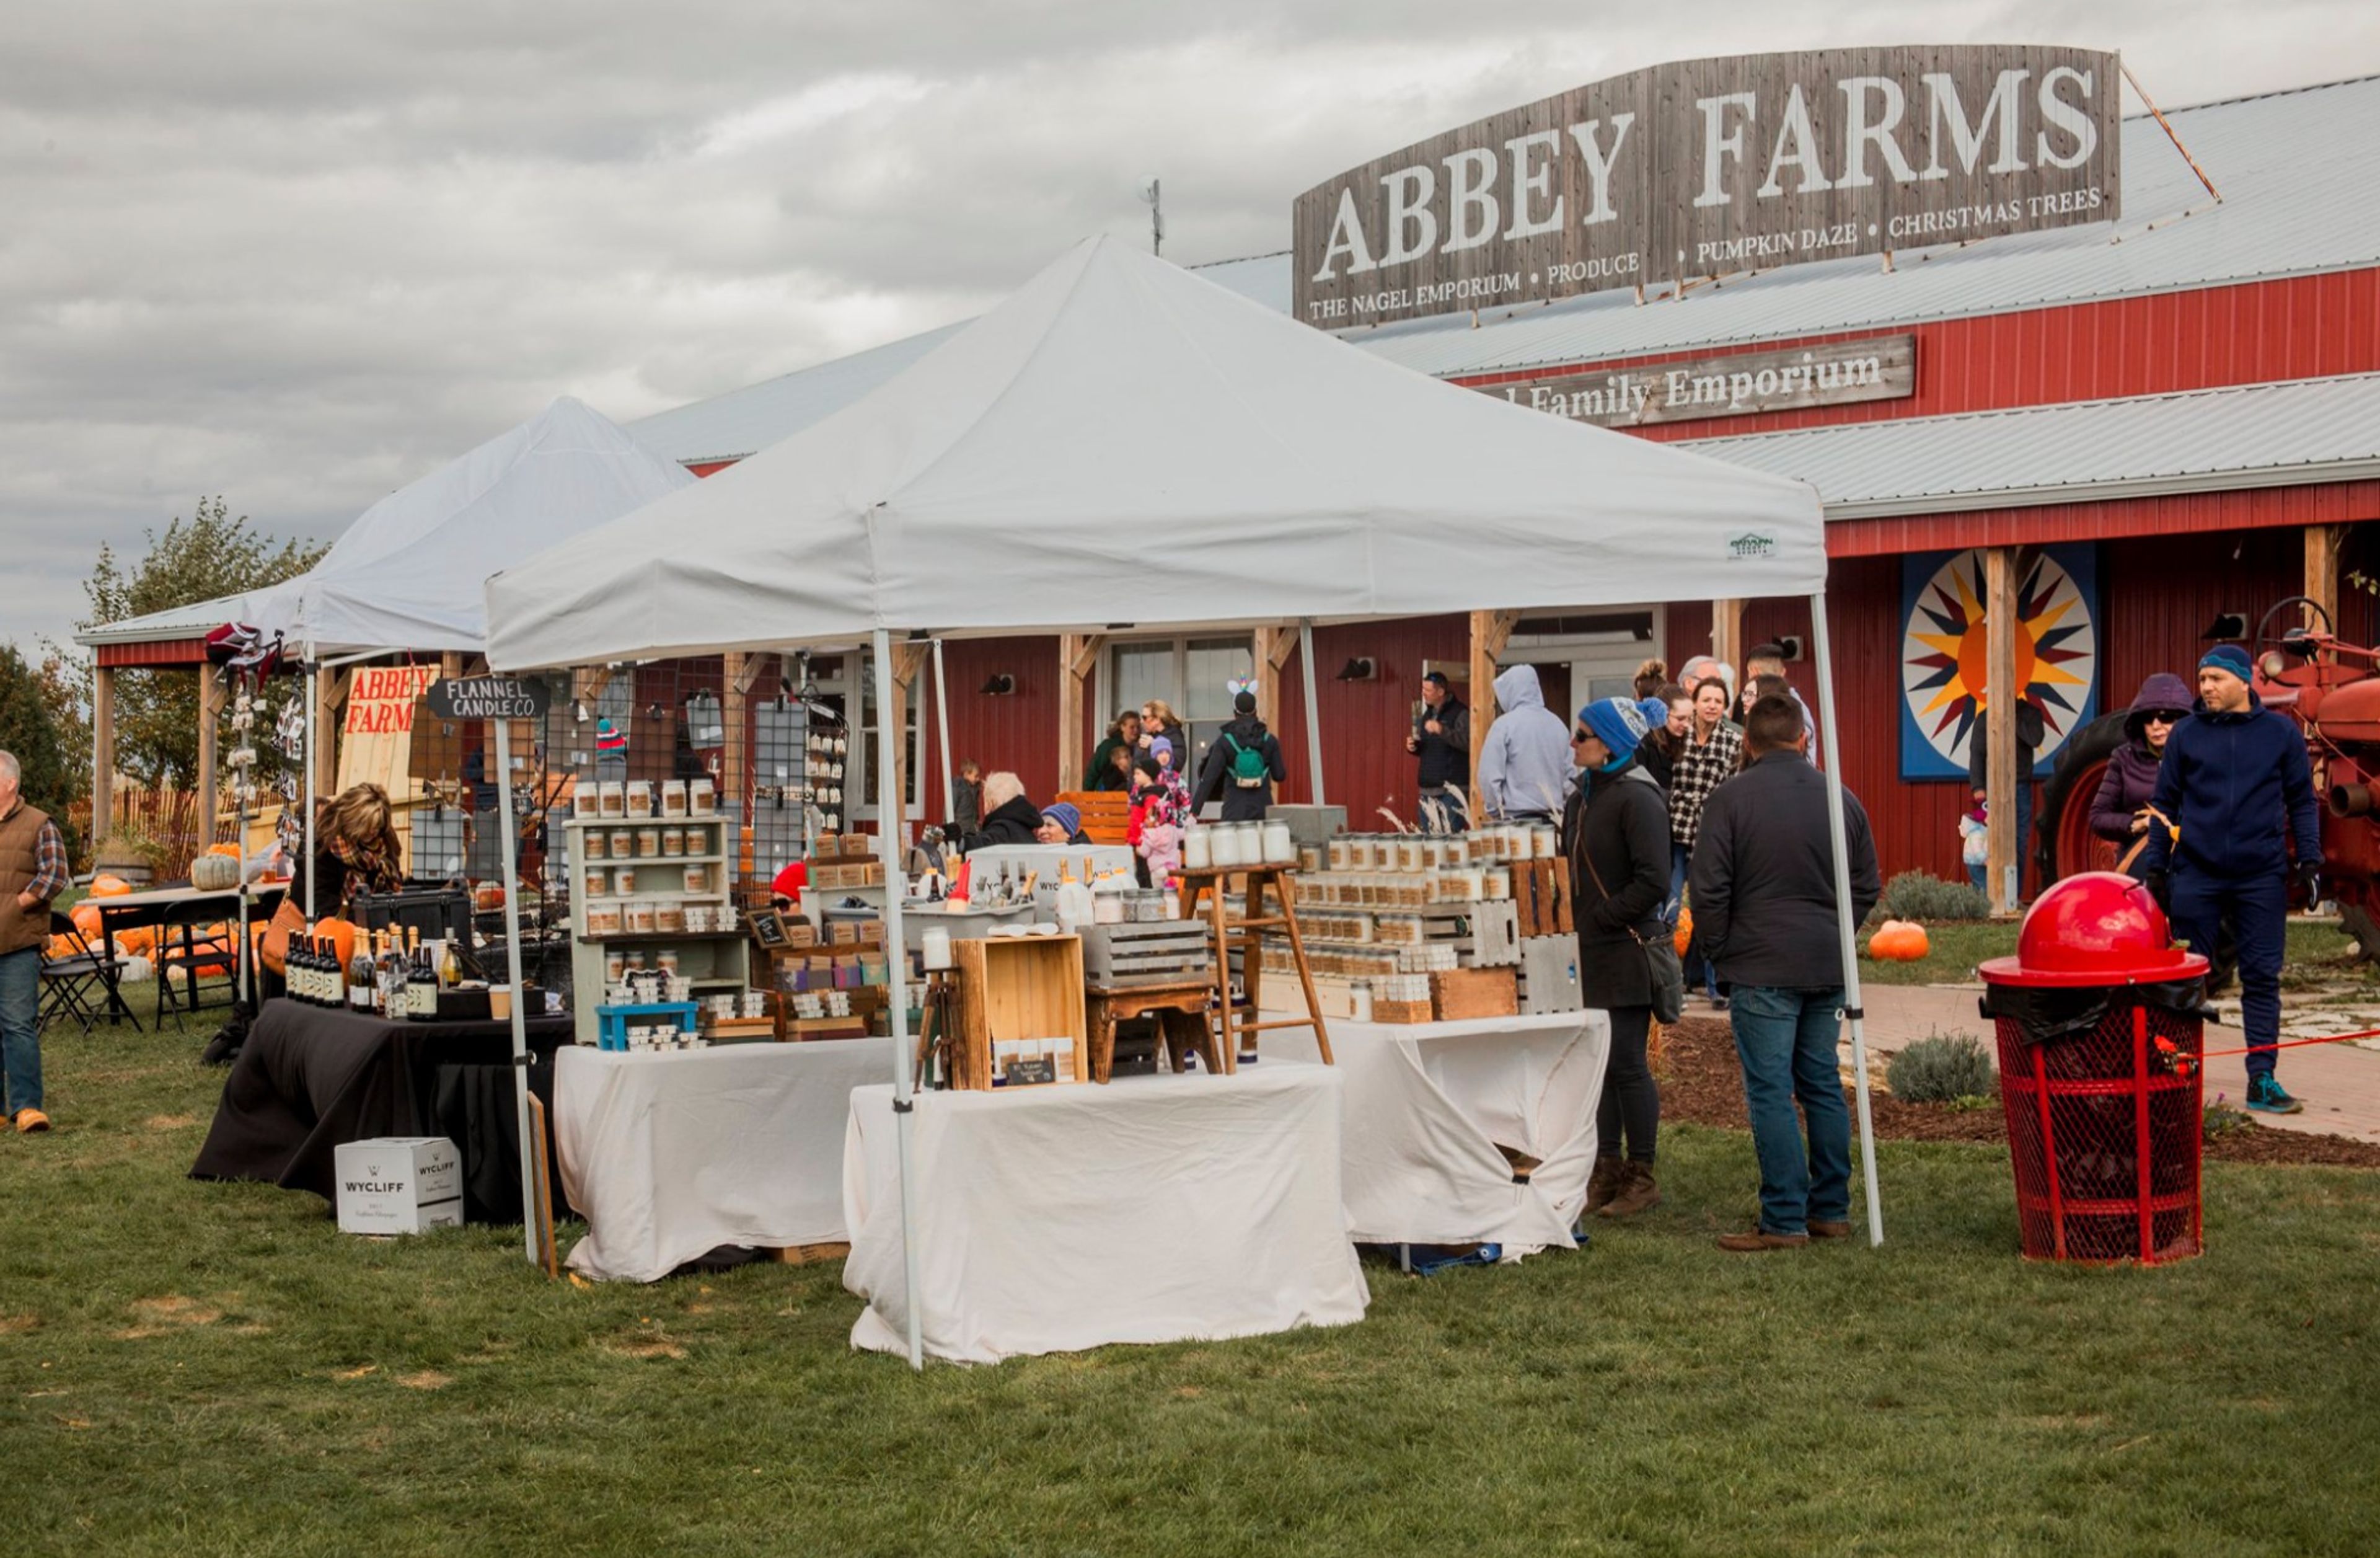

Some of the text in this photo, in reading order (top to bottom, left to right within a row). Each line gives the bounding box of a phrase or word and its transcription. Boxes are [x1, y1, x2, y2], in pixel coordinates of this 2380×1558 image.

[1311, 66, 2097, 283] ABBEY FARMS
[1310, 187, 2101, 320] THE NAGEL EMPORIUM PRODUCE PUMPKIN DAZE CHRISTMAS TREES
[1529, 352, 1882, 420] Family Emporium
[349, 668, 433, 701] ABBEY
[447, 681, 531, 699] FLANNEL
[453, 700, 511, 717] CANDLE
[419, 1161, 454, 1176] WYCLIFF
[345, 1182, 405, 1192] WYCLIFF
